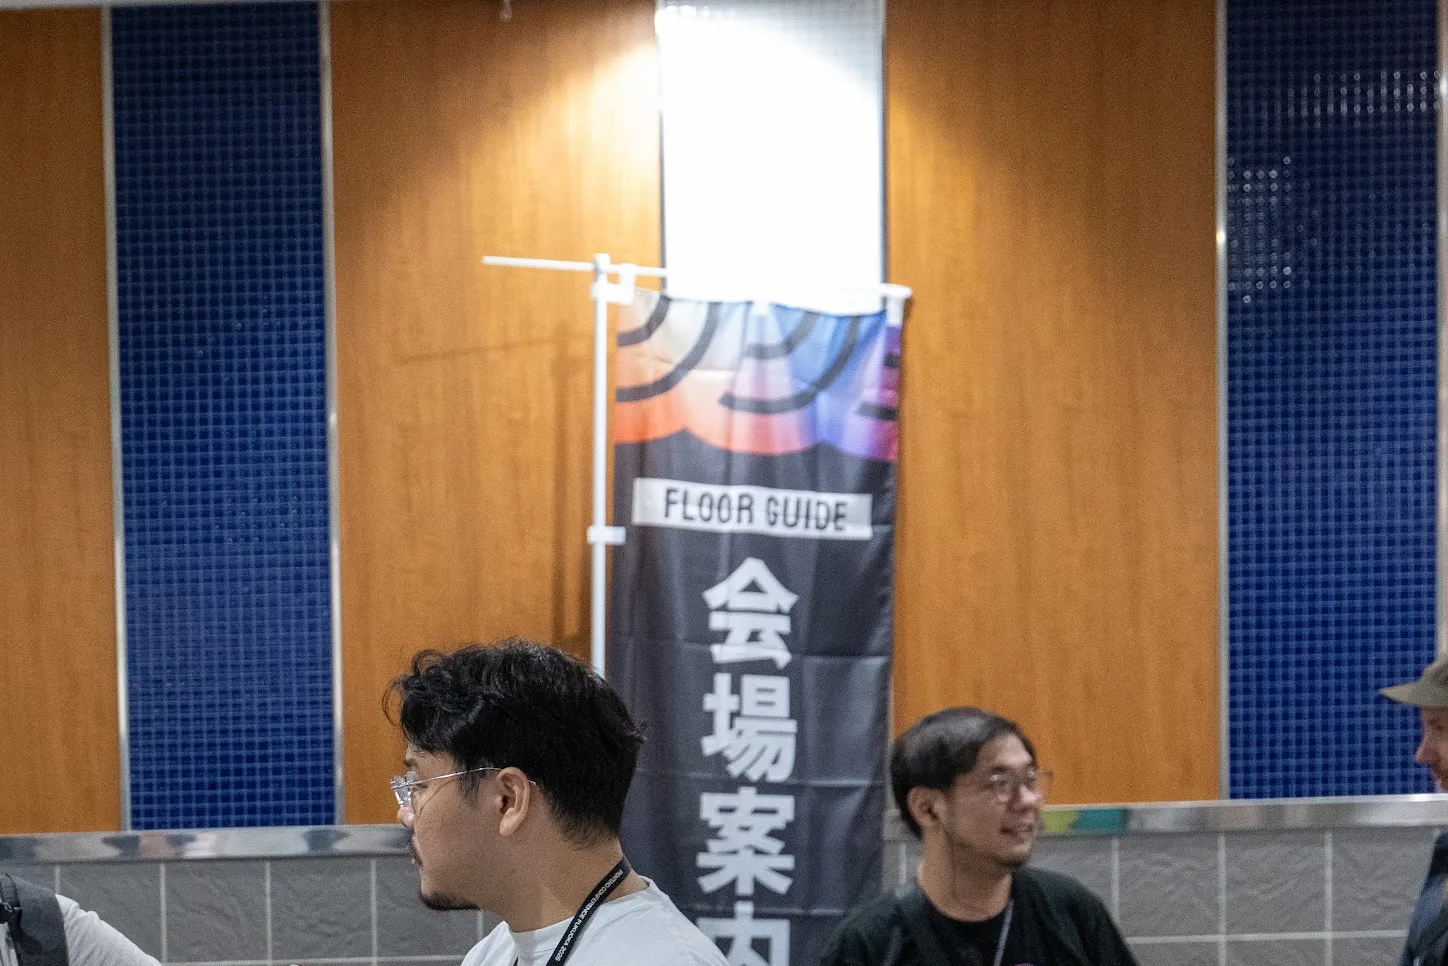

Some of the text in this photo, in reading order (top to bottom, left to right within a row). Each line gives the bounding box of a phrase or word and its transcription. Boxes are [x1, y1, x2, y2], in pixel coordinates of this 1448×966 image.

[664, 488, 847, 531] FLOOR GUIDE
[579, 886, 607, 919] CONFERENCE
[564, 918, 583, 946] FUKUOKA
